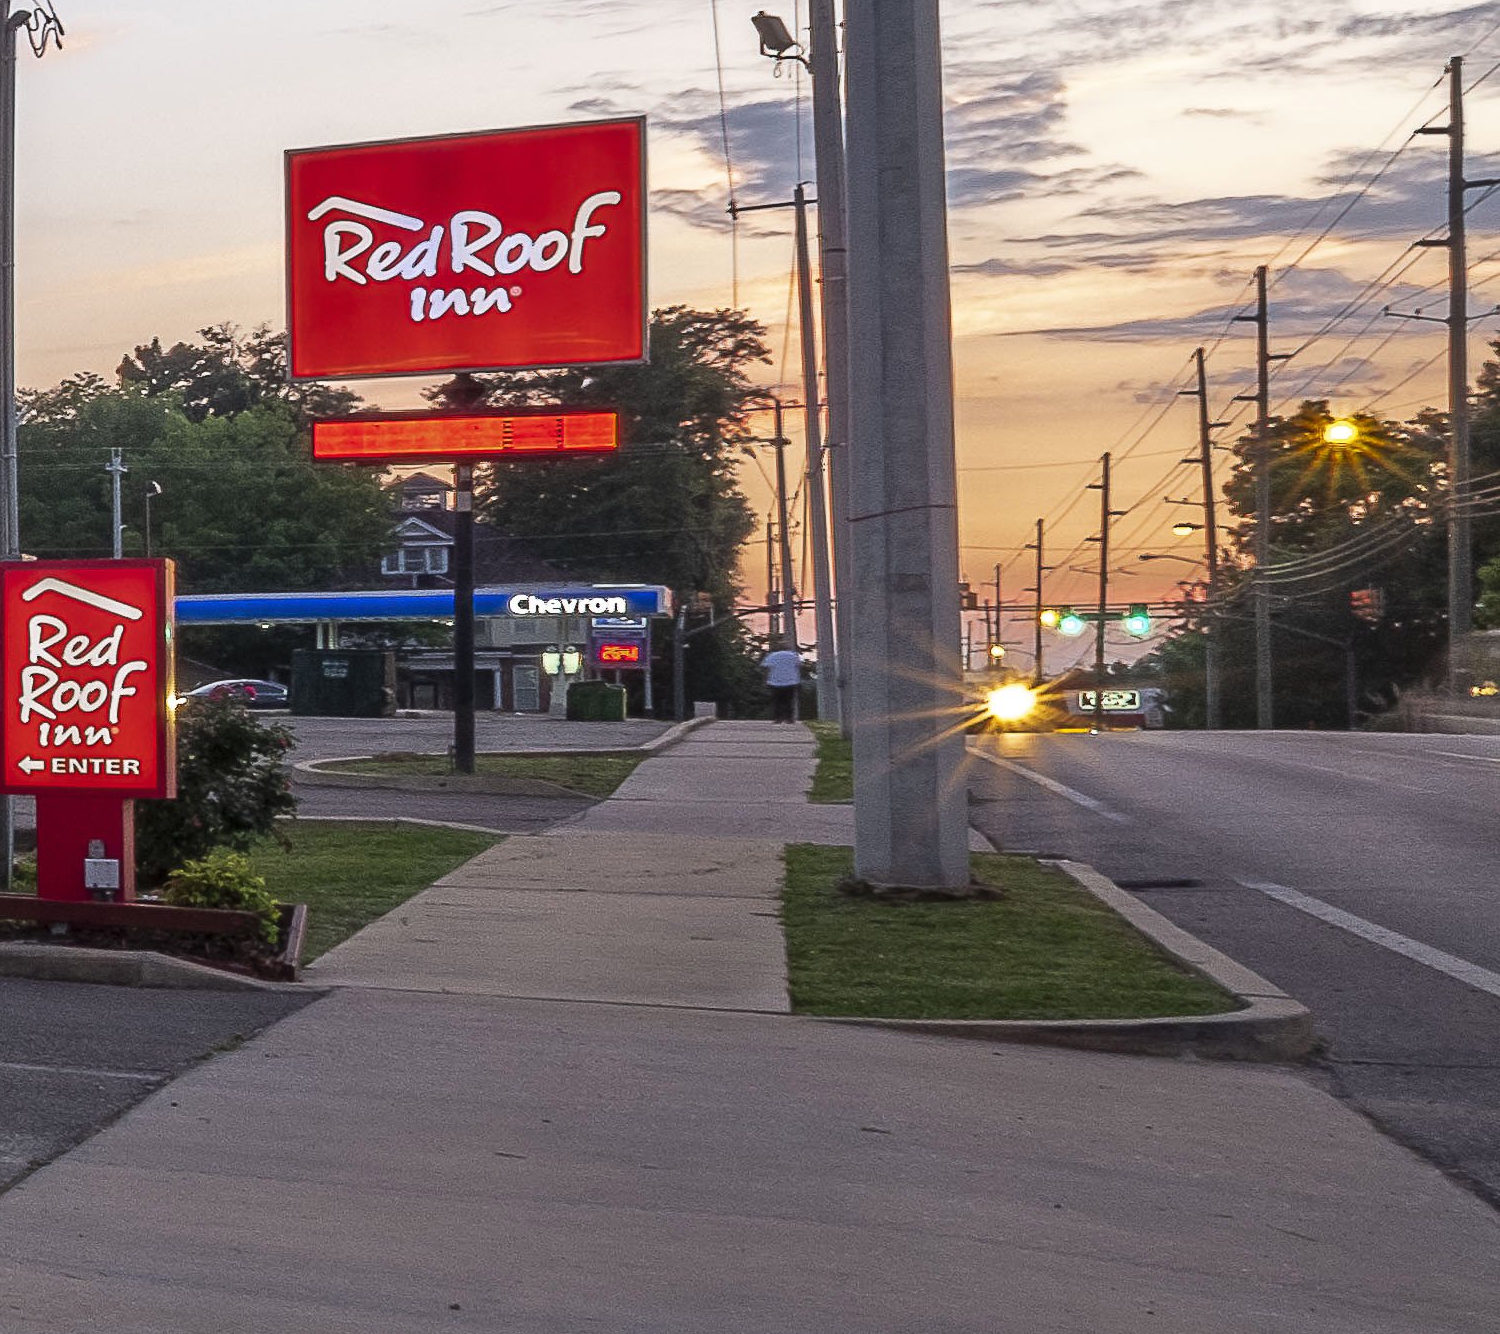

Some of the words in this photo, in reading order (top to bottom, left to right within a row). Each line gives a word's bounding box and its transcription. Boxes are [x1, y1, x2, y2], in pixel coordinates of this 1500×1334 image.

[323, 220, 444, 285] Red
[450, 190, 621, 275] Roof
[508, 594, 627, 615] Chevron
[27, 613, 123, 668] Red
[19, 660, 148, 724] Roof
[51, 757, 140, 776] ENTER
